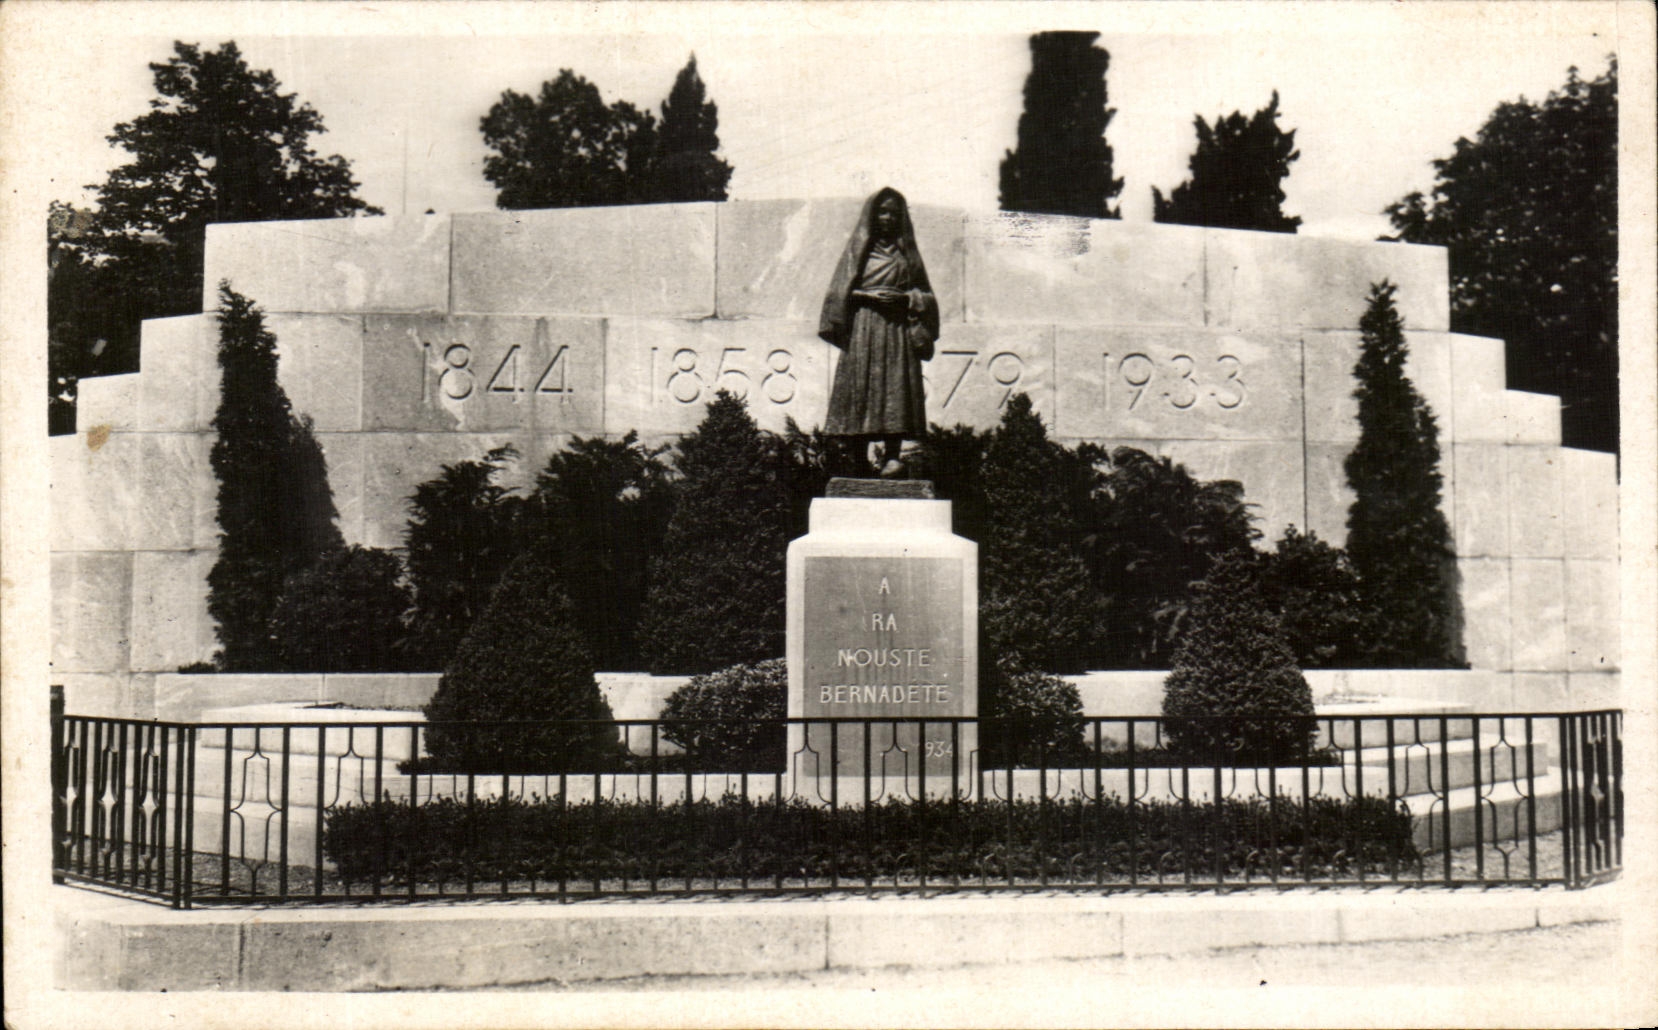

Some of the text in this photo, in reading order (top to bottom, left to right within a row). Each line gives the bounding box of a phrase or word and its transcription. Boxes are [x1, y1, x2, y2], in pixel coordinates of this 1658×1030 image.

[421, 342, 1247, 411] 1844 1858 79 1933
[878, 577, 890, 595] A
[872, 613, 897, 631] RA
[838, 649, 931, 667] NOUSTE
[820, 685, 949, 704] BERNADETE
[923, 741, 953, 758] 934
